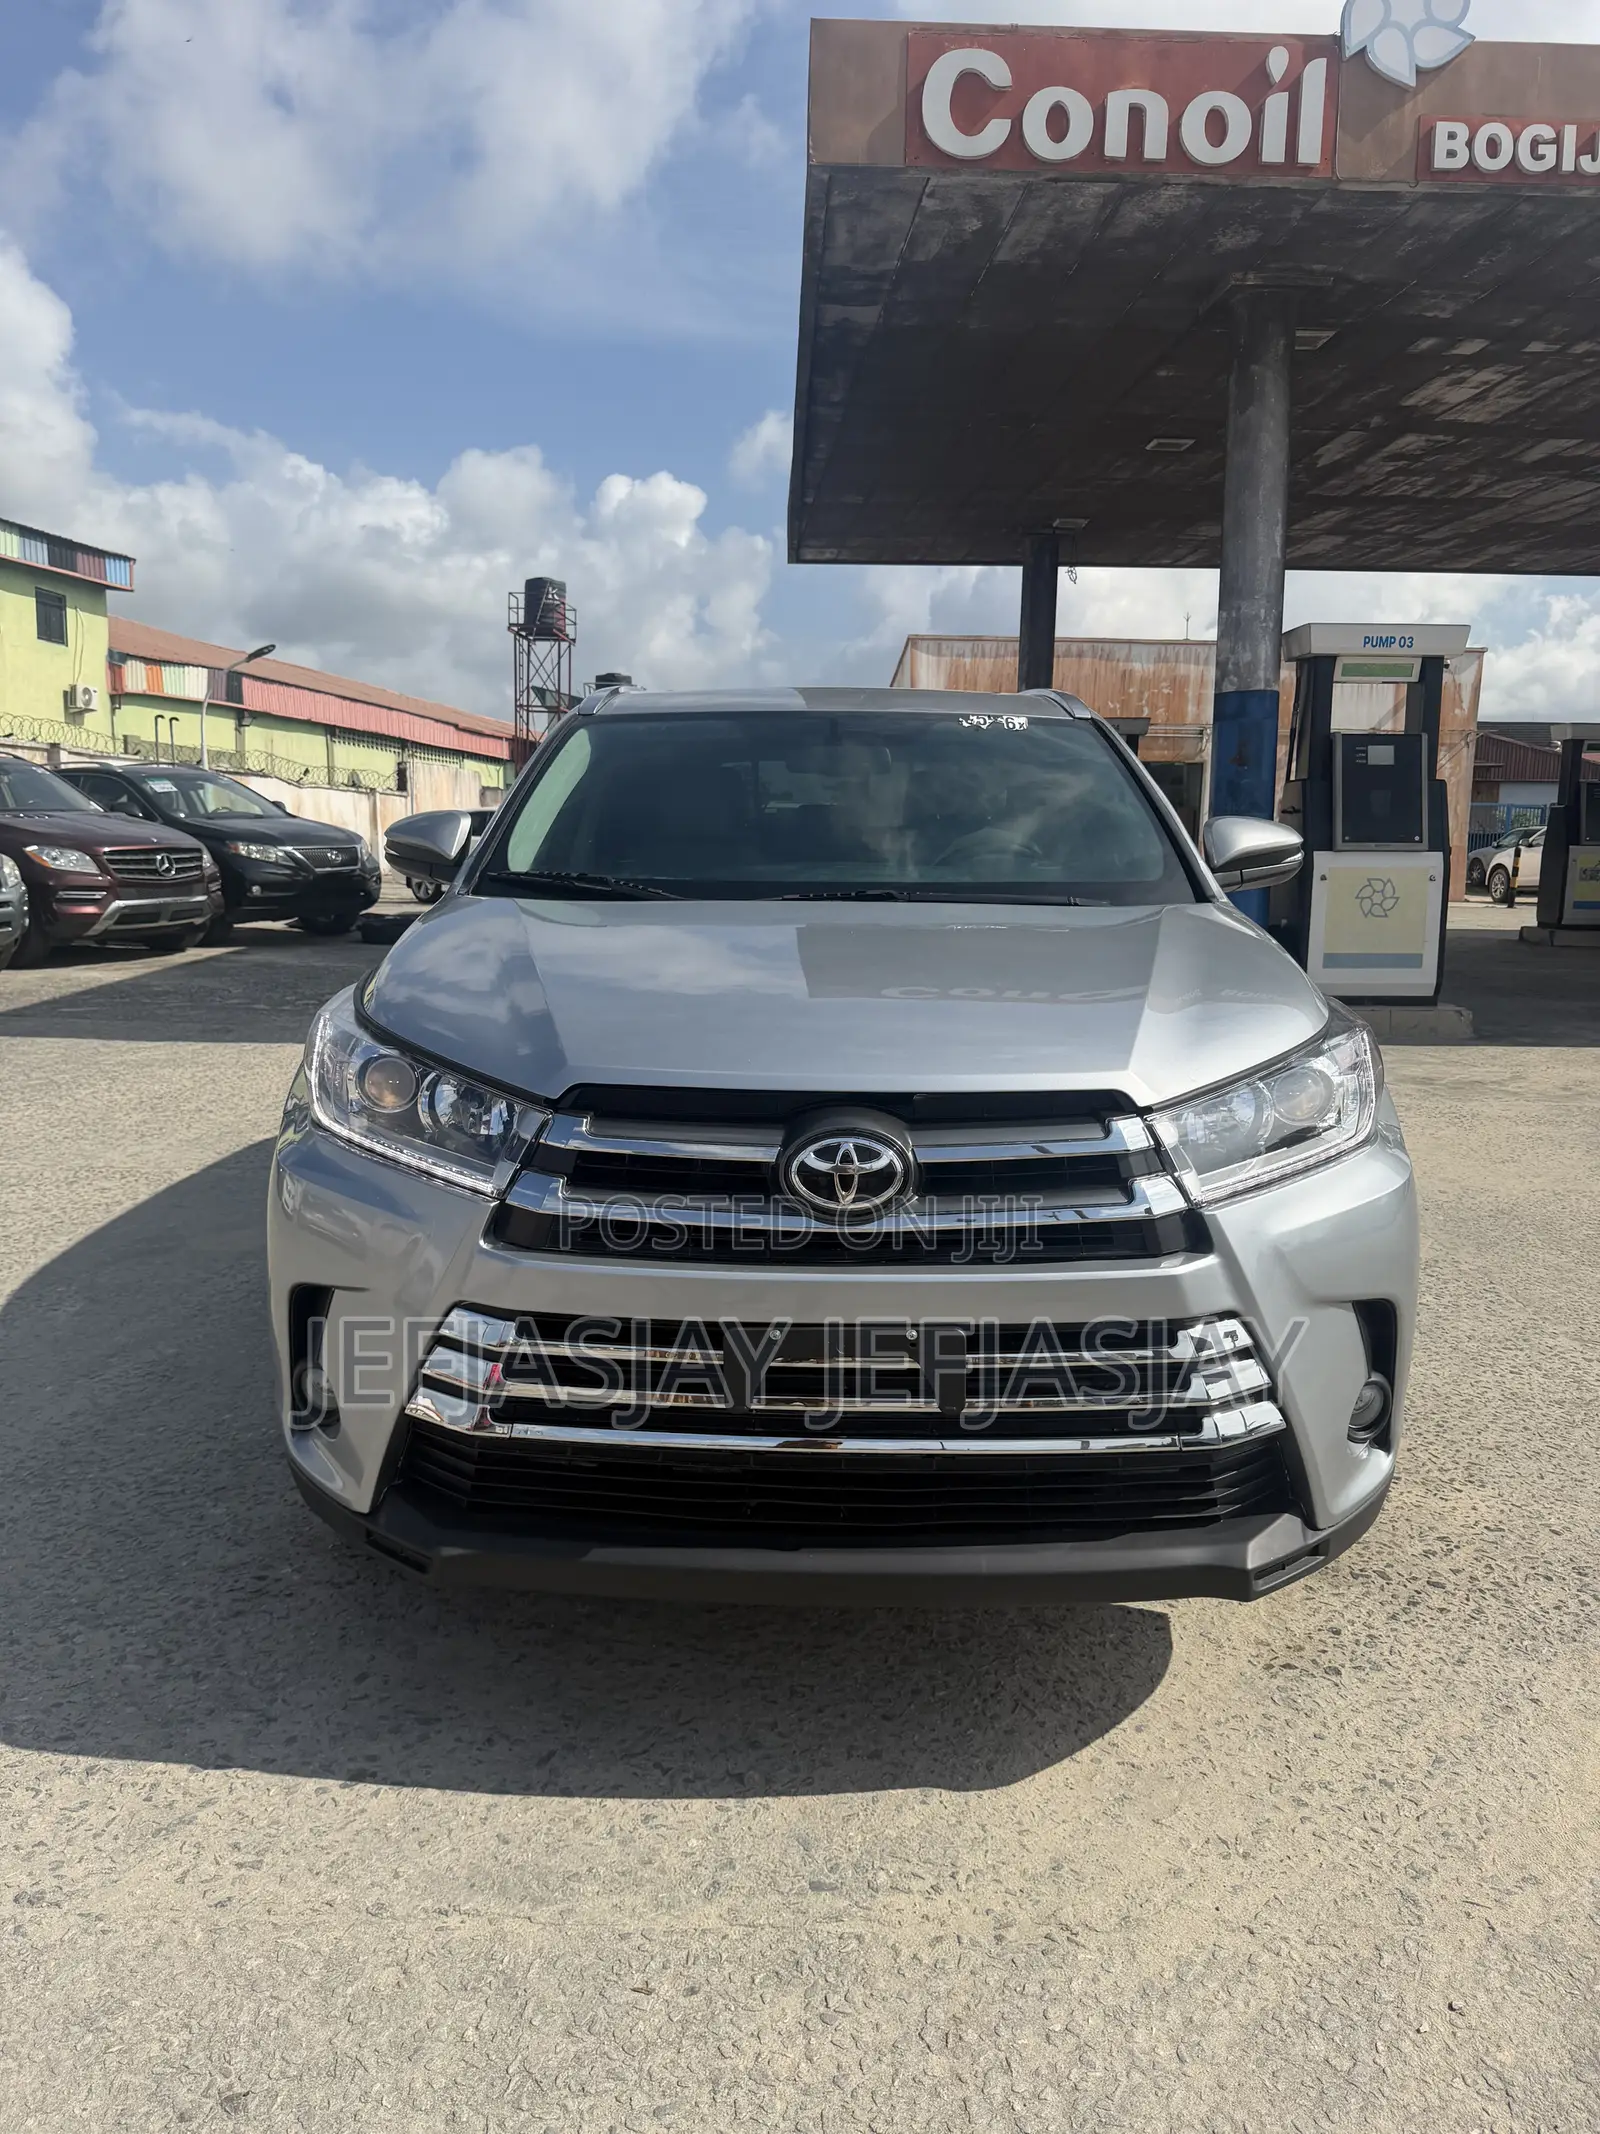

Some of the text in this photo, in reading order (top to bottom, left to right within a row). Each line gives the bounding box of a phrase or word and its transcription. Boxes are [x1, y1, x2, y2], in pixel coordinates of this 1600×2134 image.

[922, 45, 1327, 166] Conoil
[1363, 635, 1414, 649] PUMP 03
